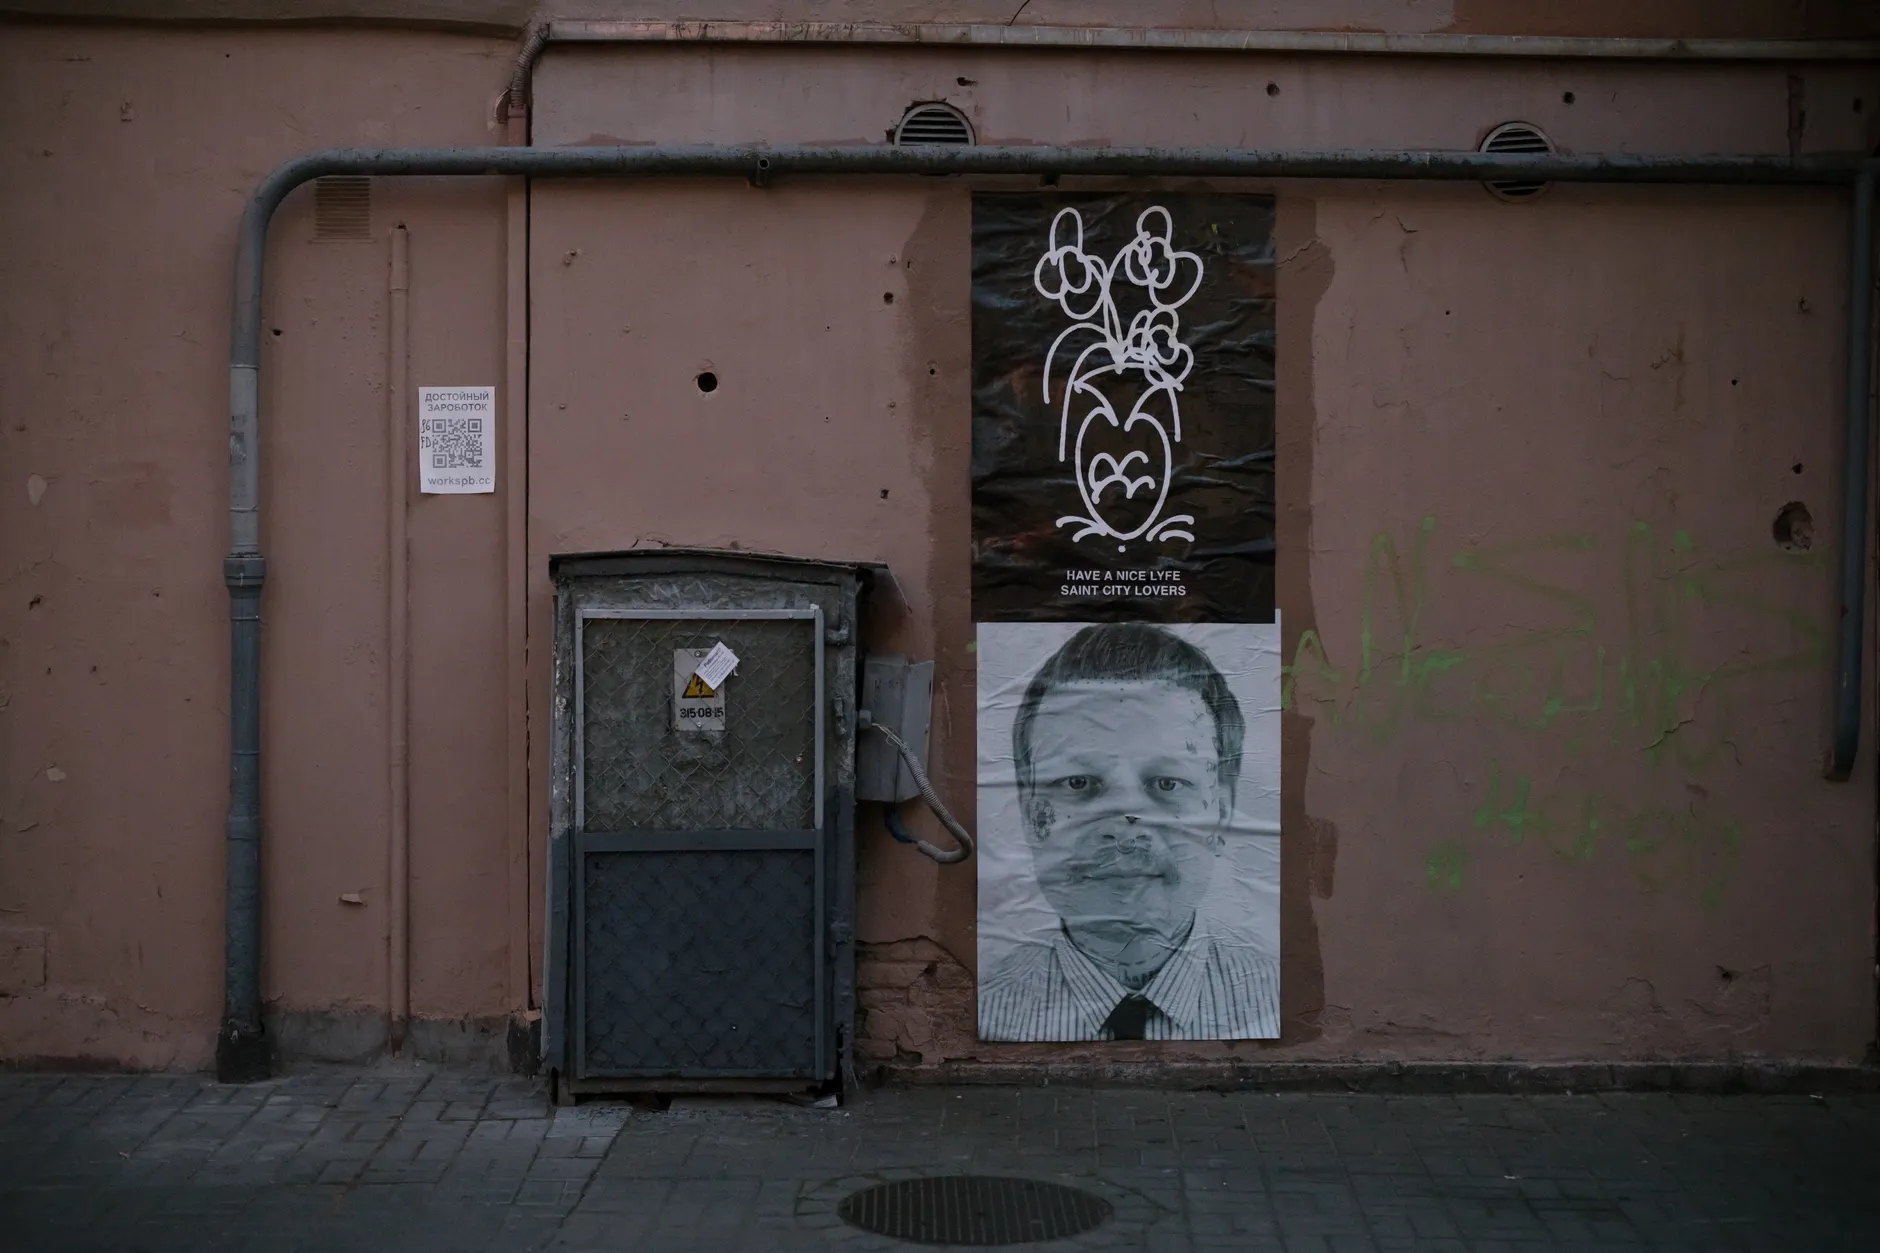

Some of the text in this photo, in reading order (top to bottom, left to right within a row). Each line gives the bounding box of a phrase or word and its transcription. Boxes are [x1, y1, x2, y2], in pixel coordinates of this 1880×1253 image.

[425, 391, 489, 402] ДОСТОЙНЫЙ
[428, 403, 487, 412] ЗАРОБОТОК
[428, 476, 491, 487] workspb.cc
[1066, 570, 1181, 581] HAVE A NICE LYFE
[1060, 585, 1187, 596] SAINT CITY LOVERS
